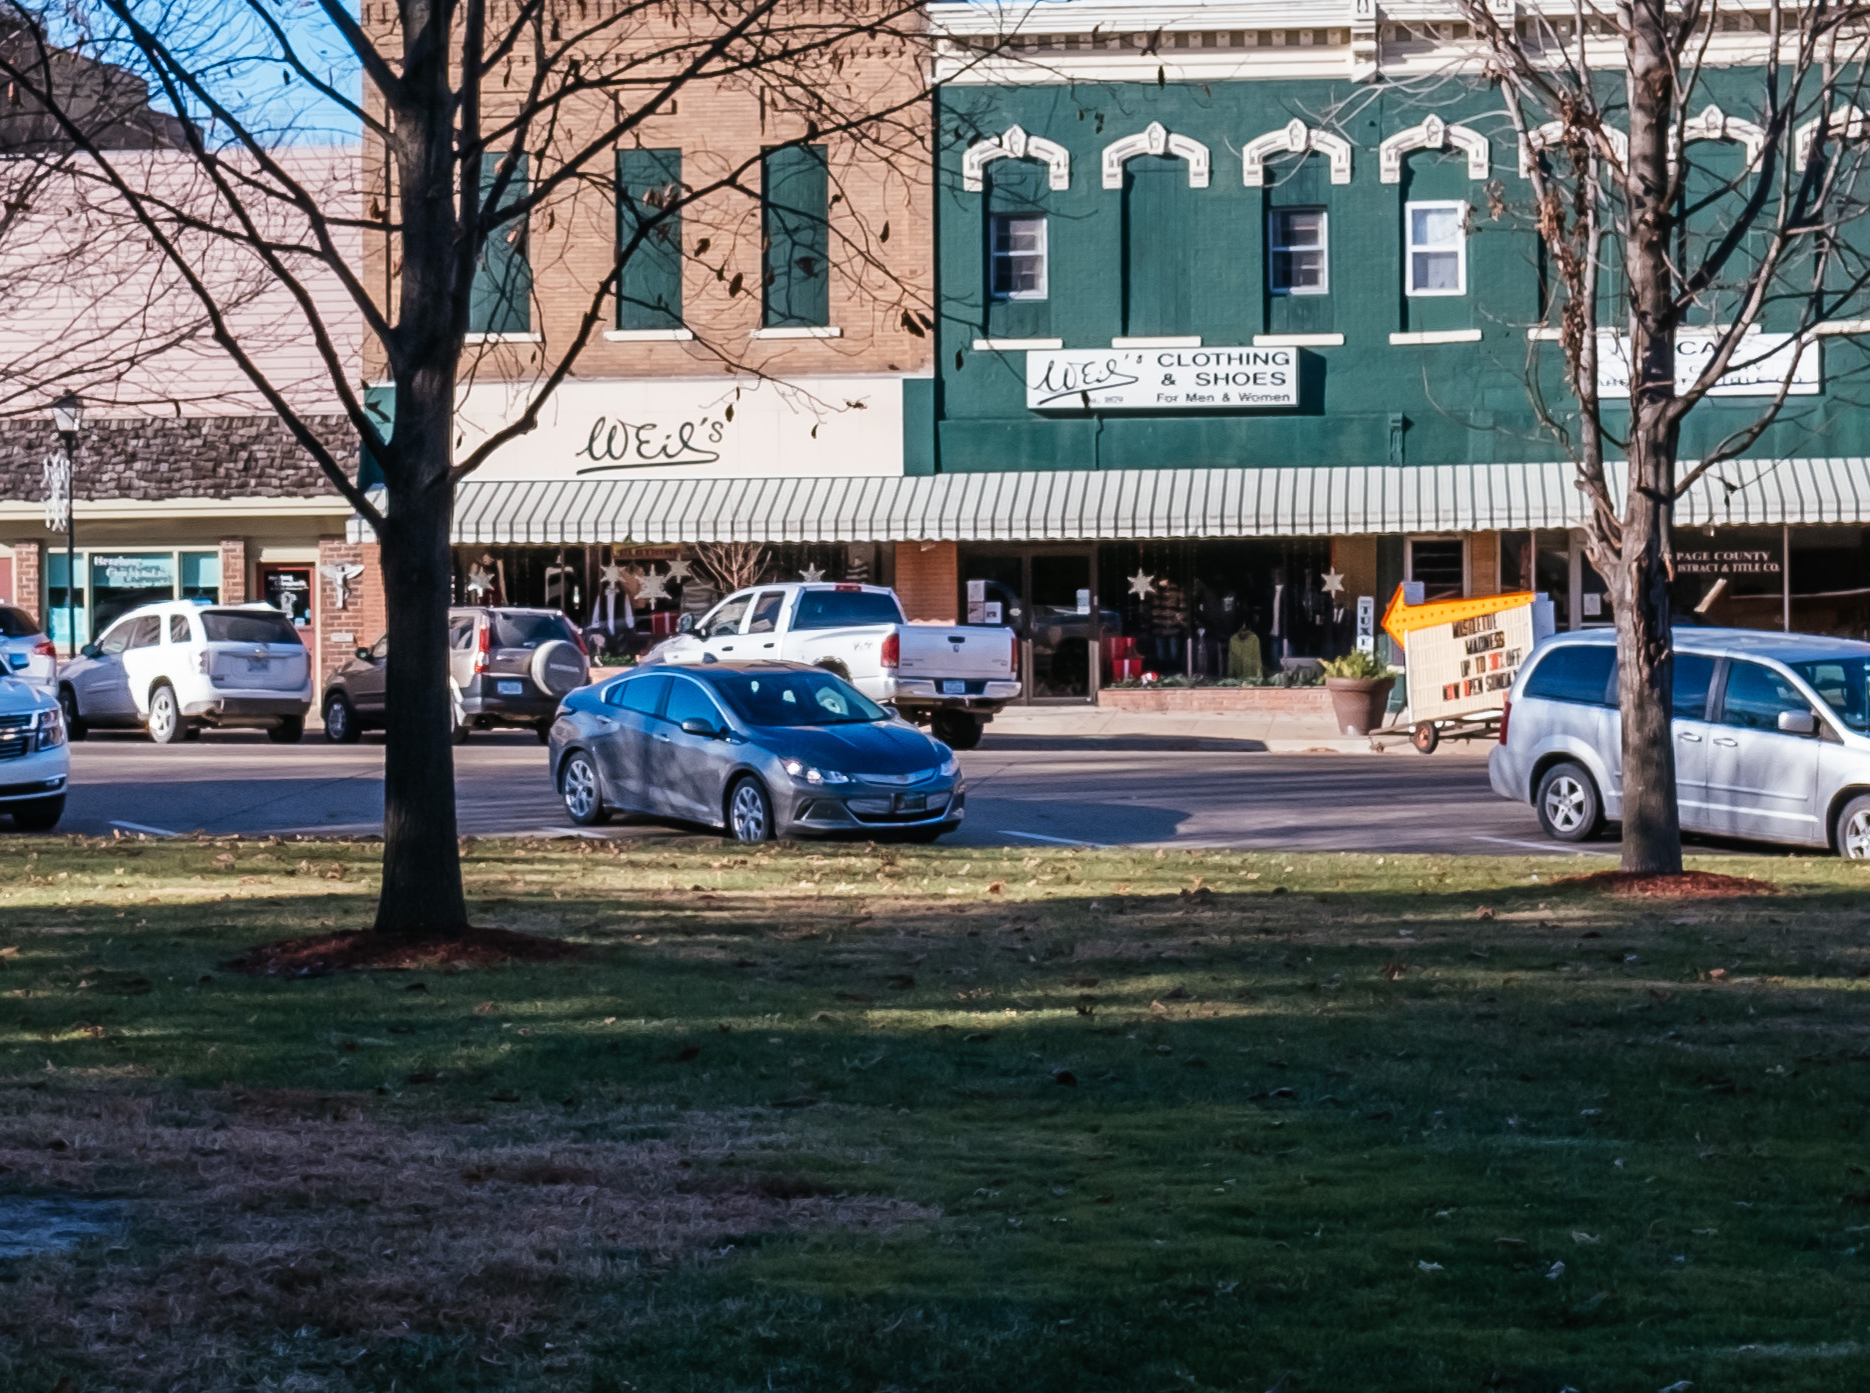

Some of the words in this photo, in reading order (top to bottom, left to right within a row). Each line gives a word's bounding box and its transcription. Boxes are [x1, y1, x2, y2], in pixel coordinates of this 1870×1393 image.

[1157, 352, 1290, 368] CLOTHING
[1161, 373, 1176, 386] &
[1195, 371, 1287, 386] SHOES
[1157, 392, 1178, 403] For
[1186, 392, 1215, 403] Men
[1222, 392, 1231, 403] &
[1238, 392, 1291, 403] Women
[1676, 551, 1710, 561] PAGE
[1714, 551, 1770, 561] COUNTY
[1732, 563, 1761, 573] TITLE
